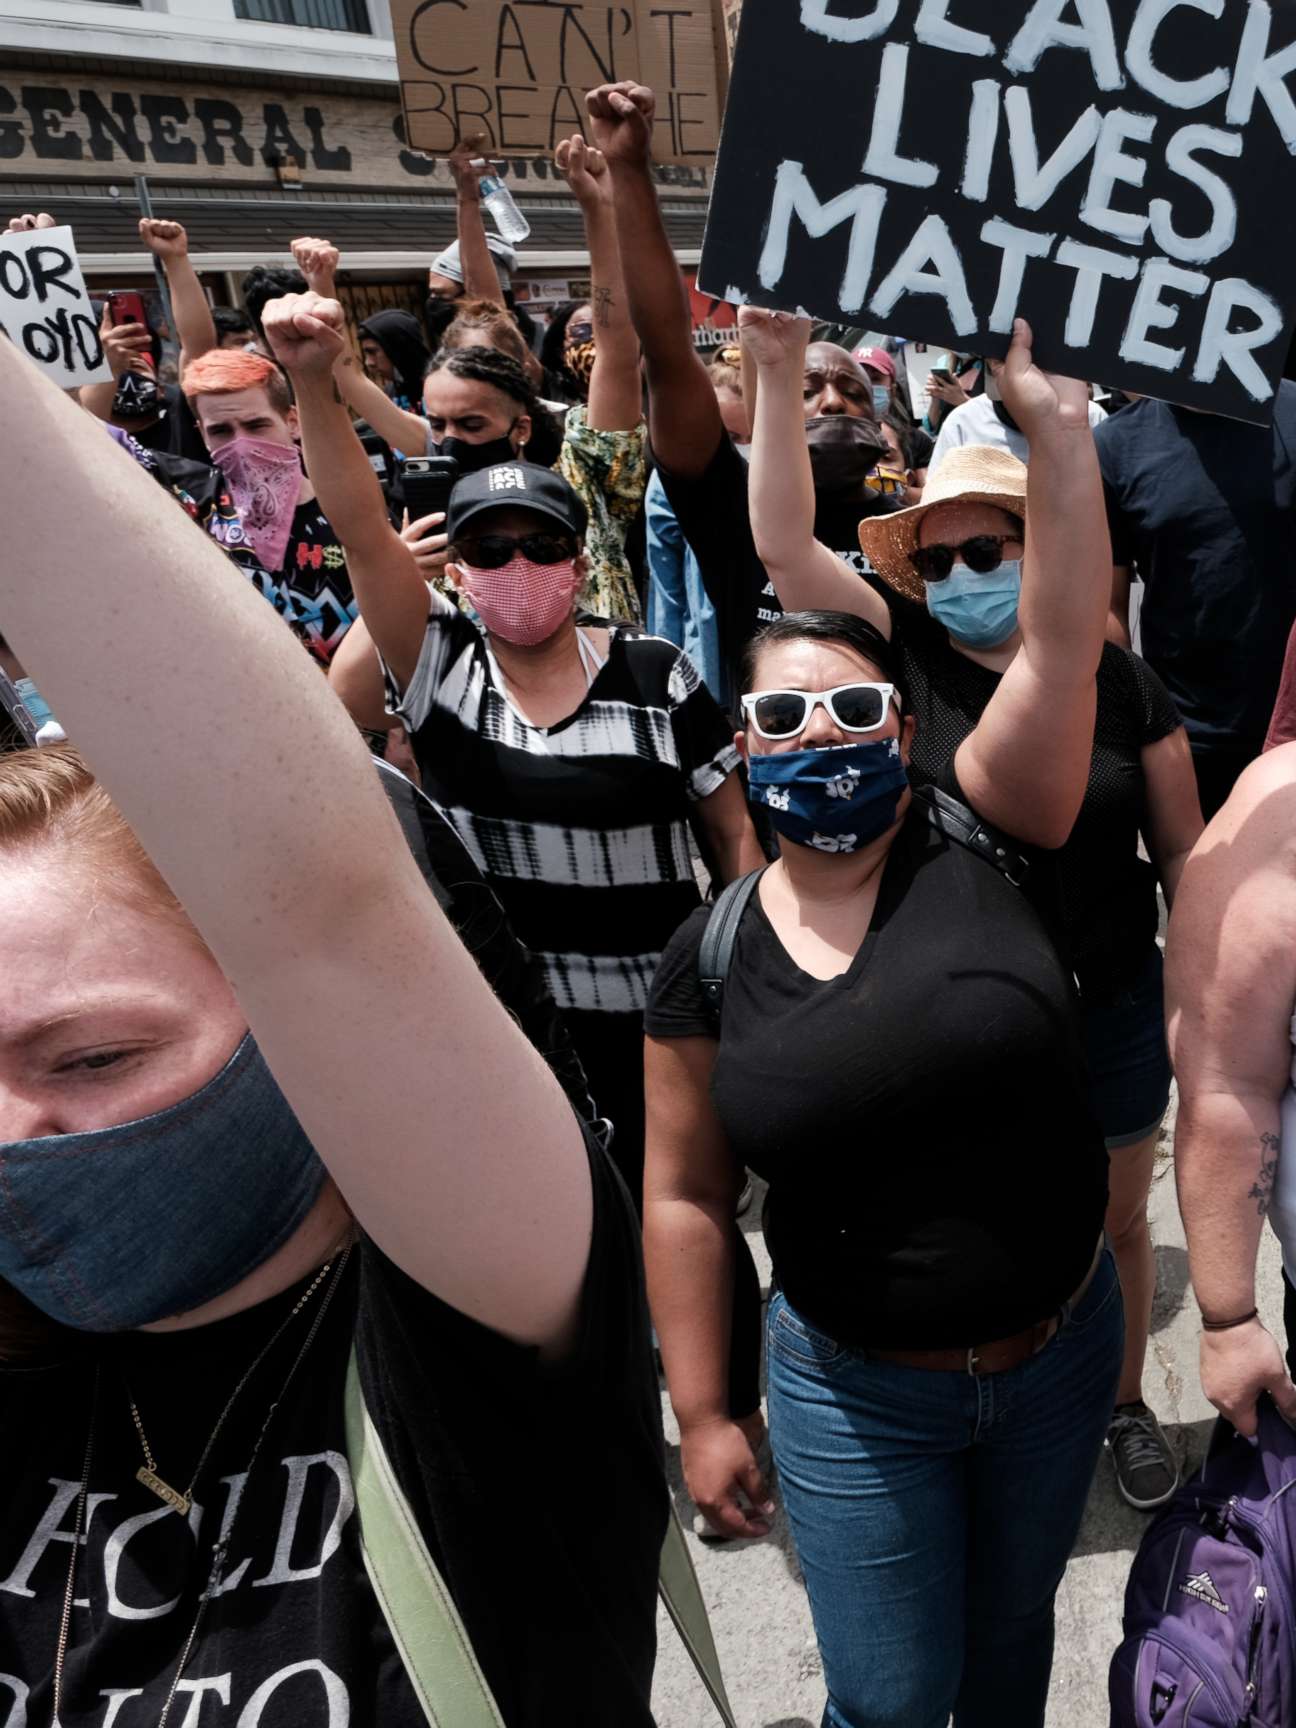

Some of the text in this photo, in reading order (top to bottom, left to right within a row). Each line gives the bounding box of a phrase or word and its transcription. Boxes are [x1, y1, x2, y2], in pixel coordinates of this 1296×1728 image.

[409, 0, 692, 88] CAN'T
[401, 79, 716, 157] BREAHE
[861, 42, 1243, 265] LIVES
[758, 158, 1284, 403] MATTER
[22, 307, 104, 374] OYD
